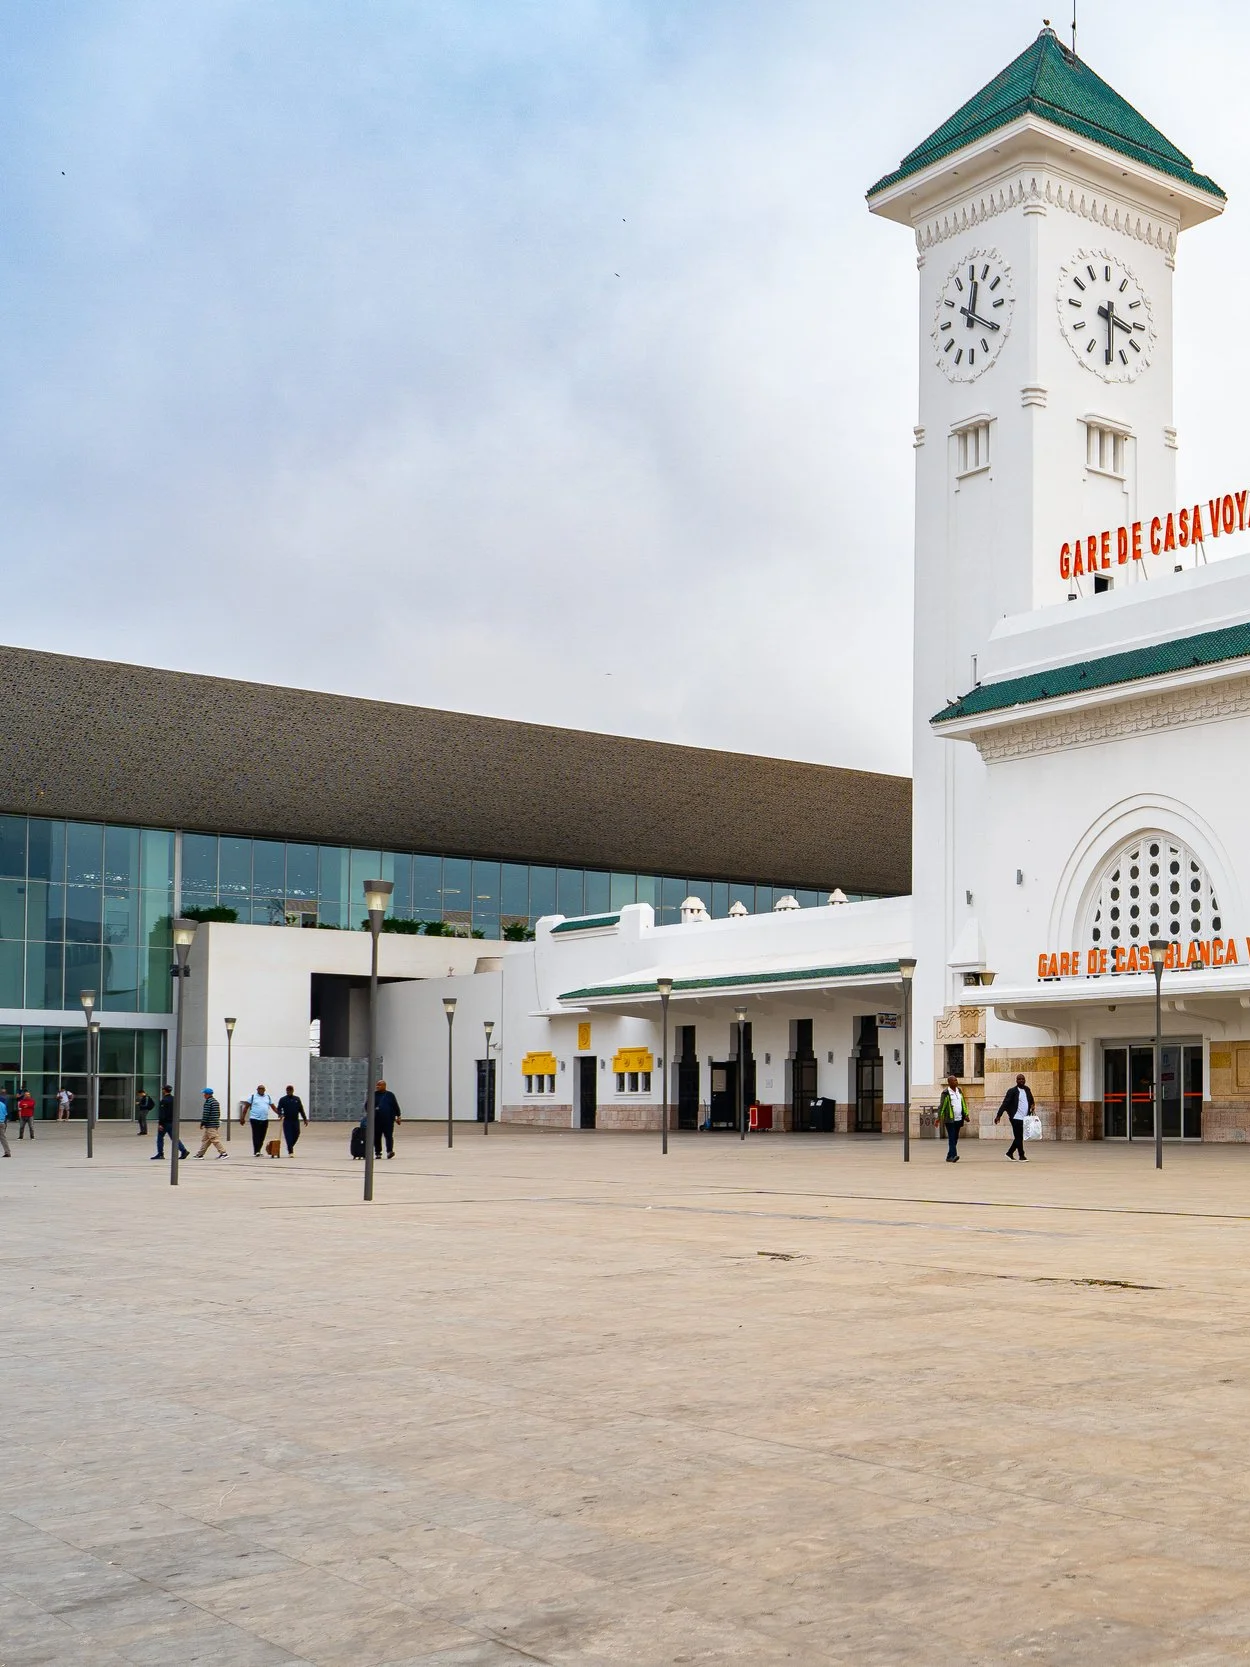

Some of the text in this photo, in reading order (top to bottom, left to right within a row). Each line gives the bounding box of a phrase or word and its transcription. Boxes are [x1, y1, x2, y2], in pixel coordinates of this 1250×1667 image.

[1059, 531, 1112, 580] GARE
[1117, 521, 1144, 565] DE
[1150, 503, 1205, 556] CASA
[1037, 951, 1080, 977] GARE
[1087, 949, 1109, 975] DE
[1114, 938, 1238, 973] CASBLANCA
